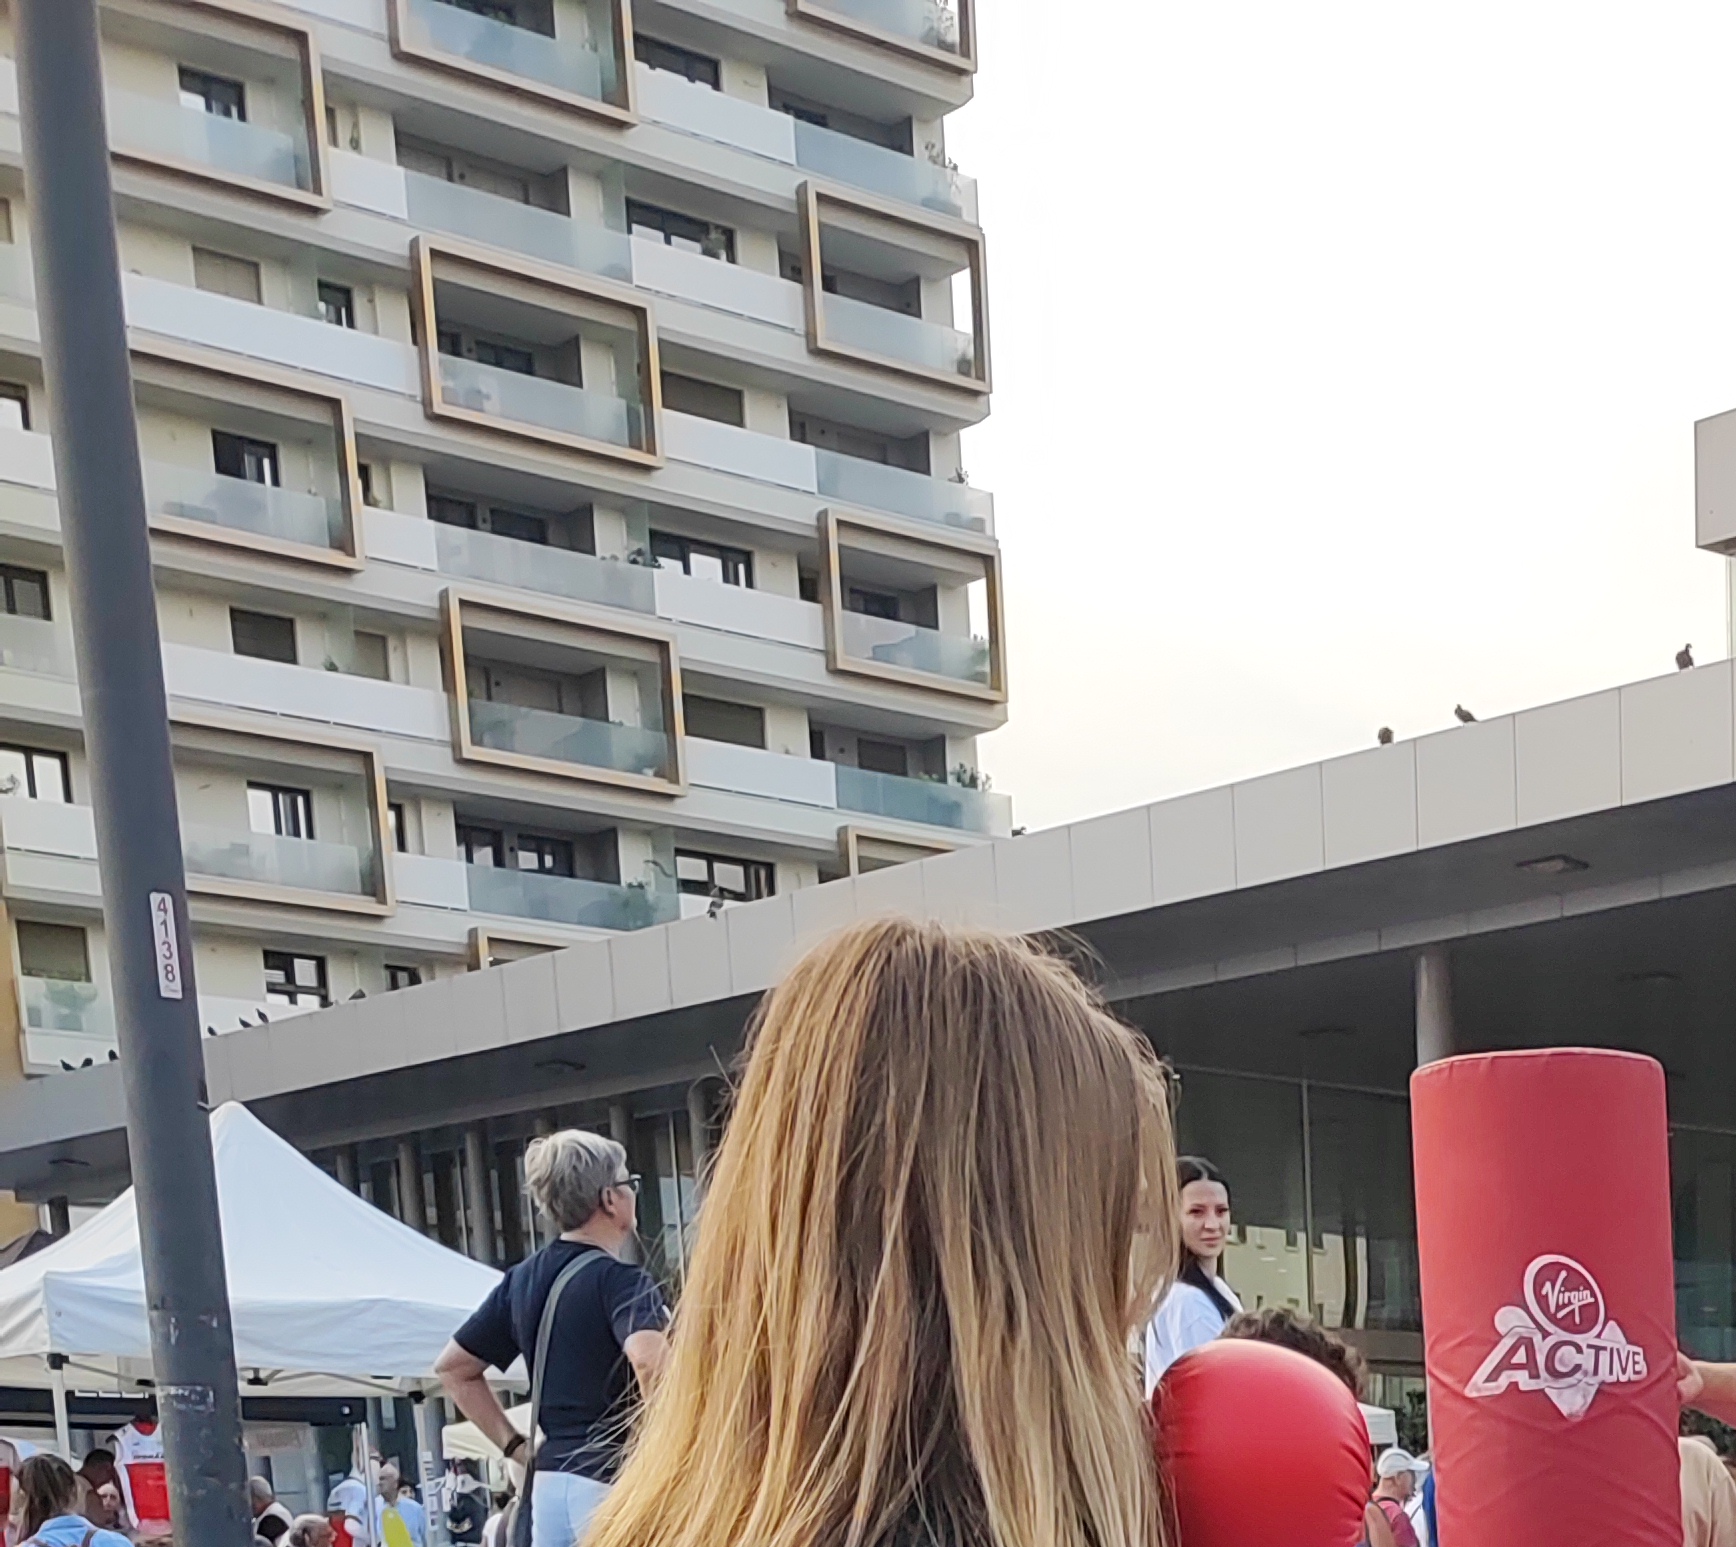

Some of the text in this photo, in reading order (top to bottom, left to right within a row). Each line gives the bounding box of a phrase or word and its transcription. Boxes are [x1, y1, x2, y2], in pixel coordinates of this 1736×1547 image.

[157, 896, 176, 983] 4138
[1541, 1269, 1595, 1325] Virgin
[1478, 1333, 1645, 1388] ACTIVE
